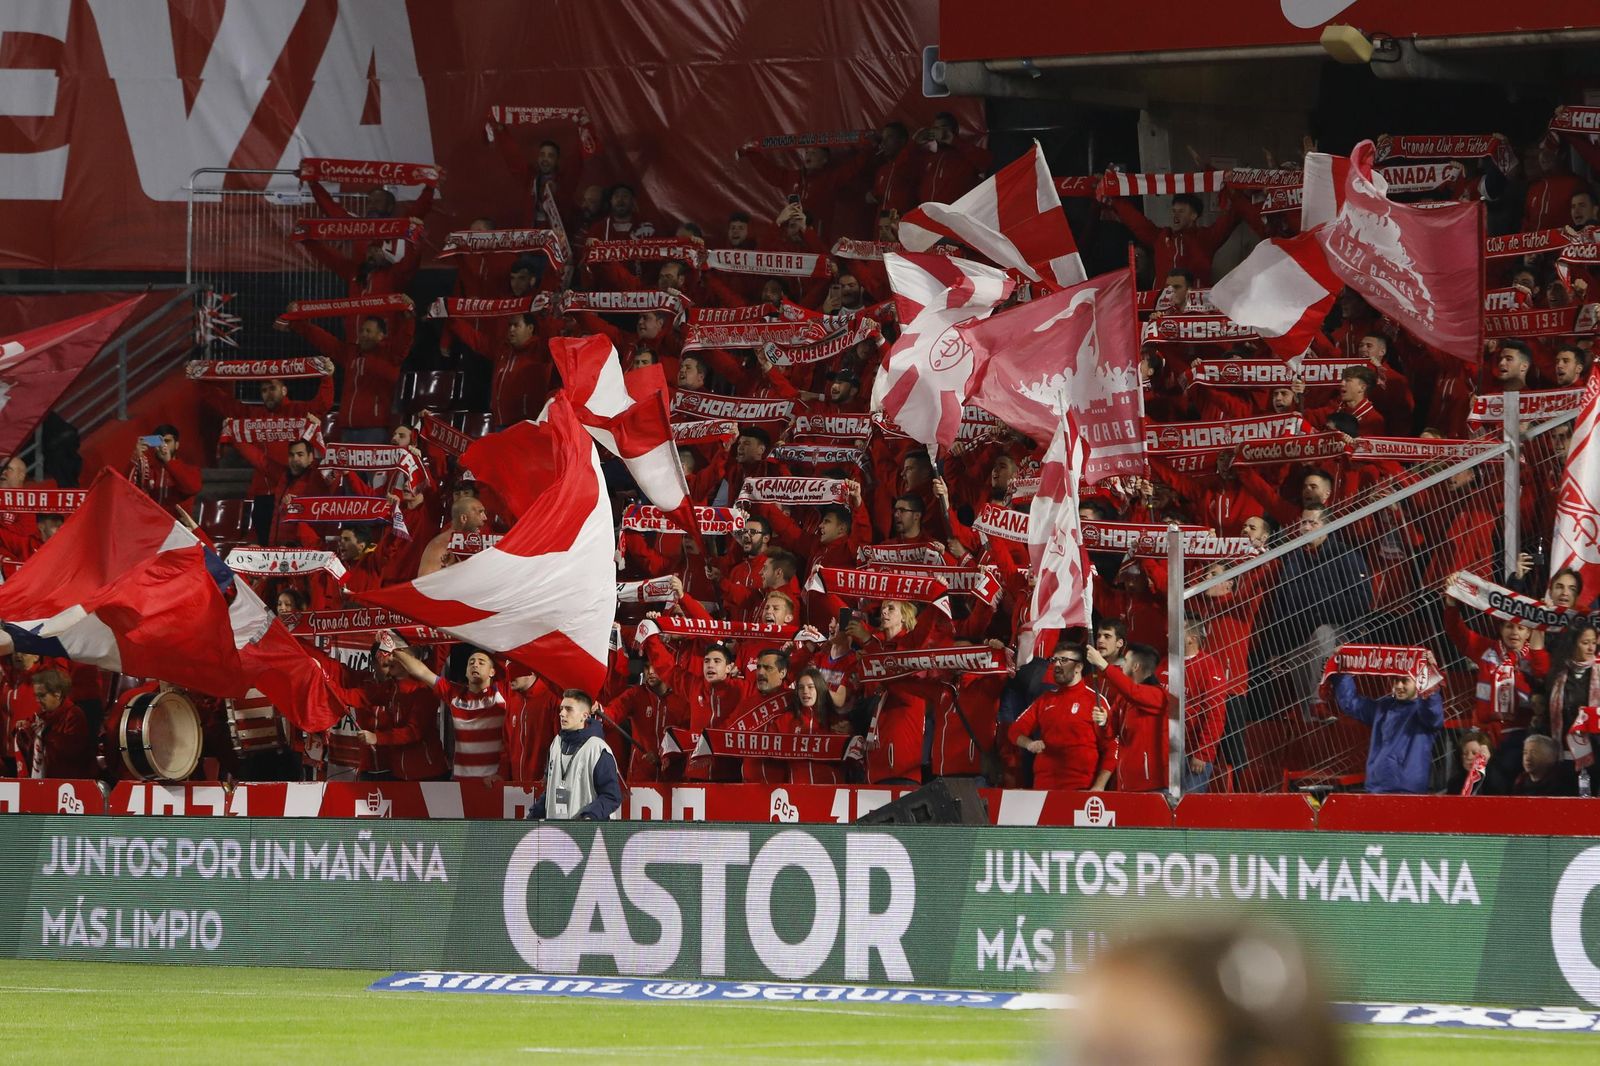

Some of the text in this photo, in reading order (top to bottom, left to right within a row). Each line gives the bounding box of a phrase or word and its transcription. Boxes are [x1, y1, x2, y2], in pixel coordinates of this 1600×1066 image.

[1400, 136, 1434, 157] Granada
[1436, 137, 1453, 153] Club
[1455, 137, 1465, 152] de
[320, 161, 375, 177] Granada
[1383, 166, 1436, 185] ANADA
[318, 222, 375, 235] GRANADA
[588, 246, 662, 262] GRANADA
[1486, 238, 1505, 253] Club
[1508, 237, 1519, 250] de
[1562, 243, 1597, 258] ranada
[1535, 312, 1565, 328] 1931
[269, 360, 279, 374] de
[1242, 441, 1282, 460] Granada
[1284, 440, 1301, 457] Club
[1304, 439, 1315, 454] de
[1375, 442, 1418, 455] GRANADA
[1421, 443, 1445, 455] CLUB
[755, 478, 807, 497] GRANADA
[4, 492, 86, 507] RADA 193
[310, 501, 369, 520] GRANADA
[981, 502, 1031, 535] GRANA
[641, 519, 662, 529] FIN
[701, 521, 733, 533] UNDO
[836, 571, 933, 595] GRADA 1931
[1488, 590, 1570, 627] GRANADA
[308, 612, 350, 633] Granada
[352, 610, 371, 627] Club
[375, 609, 386, 625] de
[862, 658, 886, 677] LA
[724, 732, 830, 753] GRADA 1931
[61, 792, 81, 813] GCF
[774, 797, 795, 819] GCF
[42, 829, 449, 883] JUNTOS POR UN MAÑANA
[975, 845, 1482, 906] JUNTOS POR UN MAÑANA
[503, 826, 916, 983] CASTOR
[42, 896, 223, 950] MÁS LIMPIO
[976, 915, 1055, 974] MÁS
[389, 973, 635, 994] Allianz
